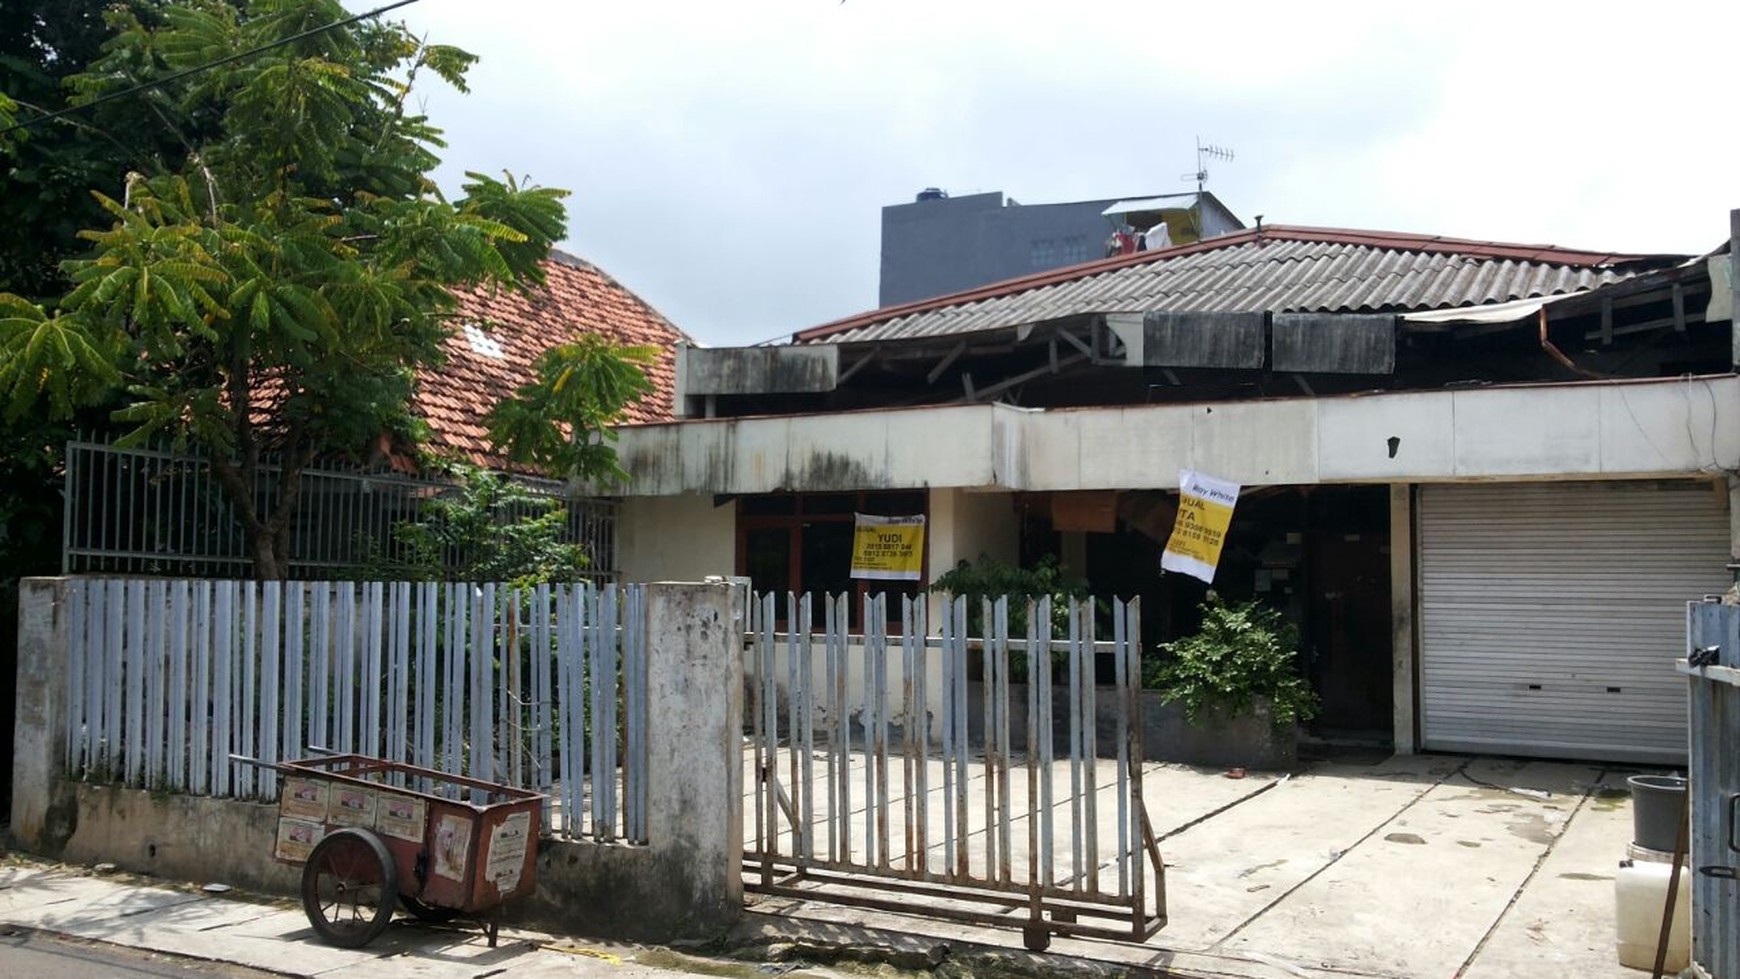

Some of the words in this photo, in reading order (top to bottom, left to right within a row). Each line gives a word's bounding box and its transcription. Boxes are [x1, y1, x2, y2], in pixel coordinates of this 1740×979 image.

[1192, 484, 1209, 496] Ray
[1209, 488, 1235, 503] White
[878, 533, 903, 543] YUDI
